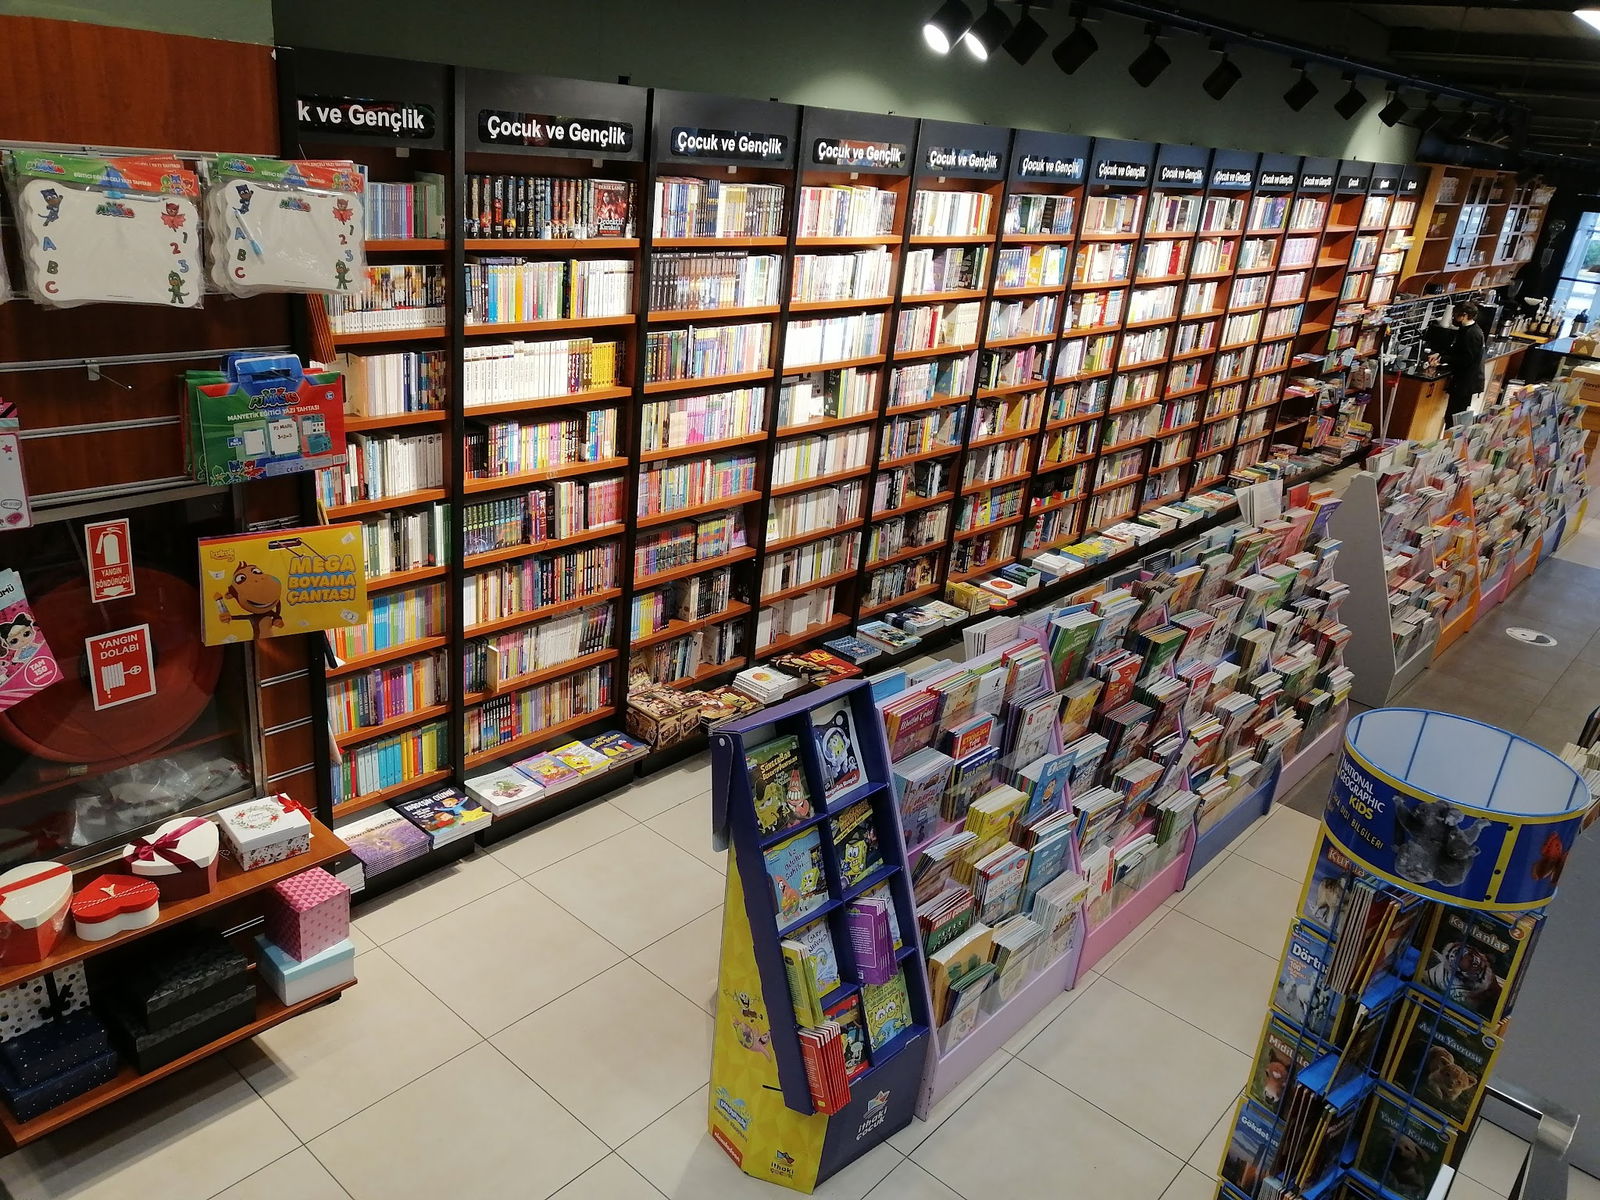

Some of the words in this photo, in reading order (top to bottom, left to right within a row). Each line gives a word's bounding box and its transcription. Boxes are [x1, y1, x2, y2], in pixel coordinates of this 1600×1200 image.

[317, 105, 342, 124] ve
[349, 104, 425, 132] Gençlik
[487, 115, 542, 139] Çocuk
[546, 123, 565, 139] ve
[568, 122, 626, 148] Gençlik
[677, 131, 718, 152] Çocuk
[721, 136, 736, 151] ve
[738, 134, 782, 156] Gençlik
[818, 141, 850, 160] Çocuk
[853, 146, 865, 158] ve
[866, 145, 901, 163] Gençlik
[930, 150, 956, 167] Çocuk
[958, 154, 967, 165] ve
[968, 153, 999, 170] Gençlik
[1023, 156, 1045, 175] Çocuk
[1046, 162, 1054, 171] ve
[1055, 159, 1080, 175] Gençlik
[1099, 163, 1118, 177] Çocuk
[1119, 166, 1125, 175] ve
[1125, 165, 1147, 180] Gençlik
[234, 227, 247, 240] A
[338, 233, 348, 245] 2
[43, 236, 56, 251] A
[169, 242, 181, 255] 2
[236, 248, 247, 261] B
[345, 250, 354, 262] 3
[46, 260, 59, 275] B
[178, 259, 190, 273] 3
[234, 267, 246, 279] C
[45, 280, 59, 294] C
[100, 566, 122, 578] YANGIN
[289, 554, 356, 575] MEGA
[95, 575, 130, 589] SÖNDÜRÜCÜ
[287, 574, 357, 590] BOYAMA
[286, 586, 356, 606] ÇANTASI
[99, 633, 138, 650] YANGIN
[100, 643, 140, 660] DOLABI
[29, 659, 46, 671] TAM
[1343, 758, 1373, 795] NATIONAL
[1340, 769, 1386, 814] GEOGRAPHIC
